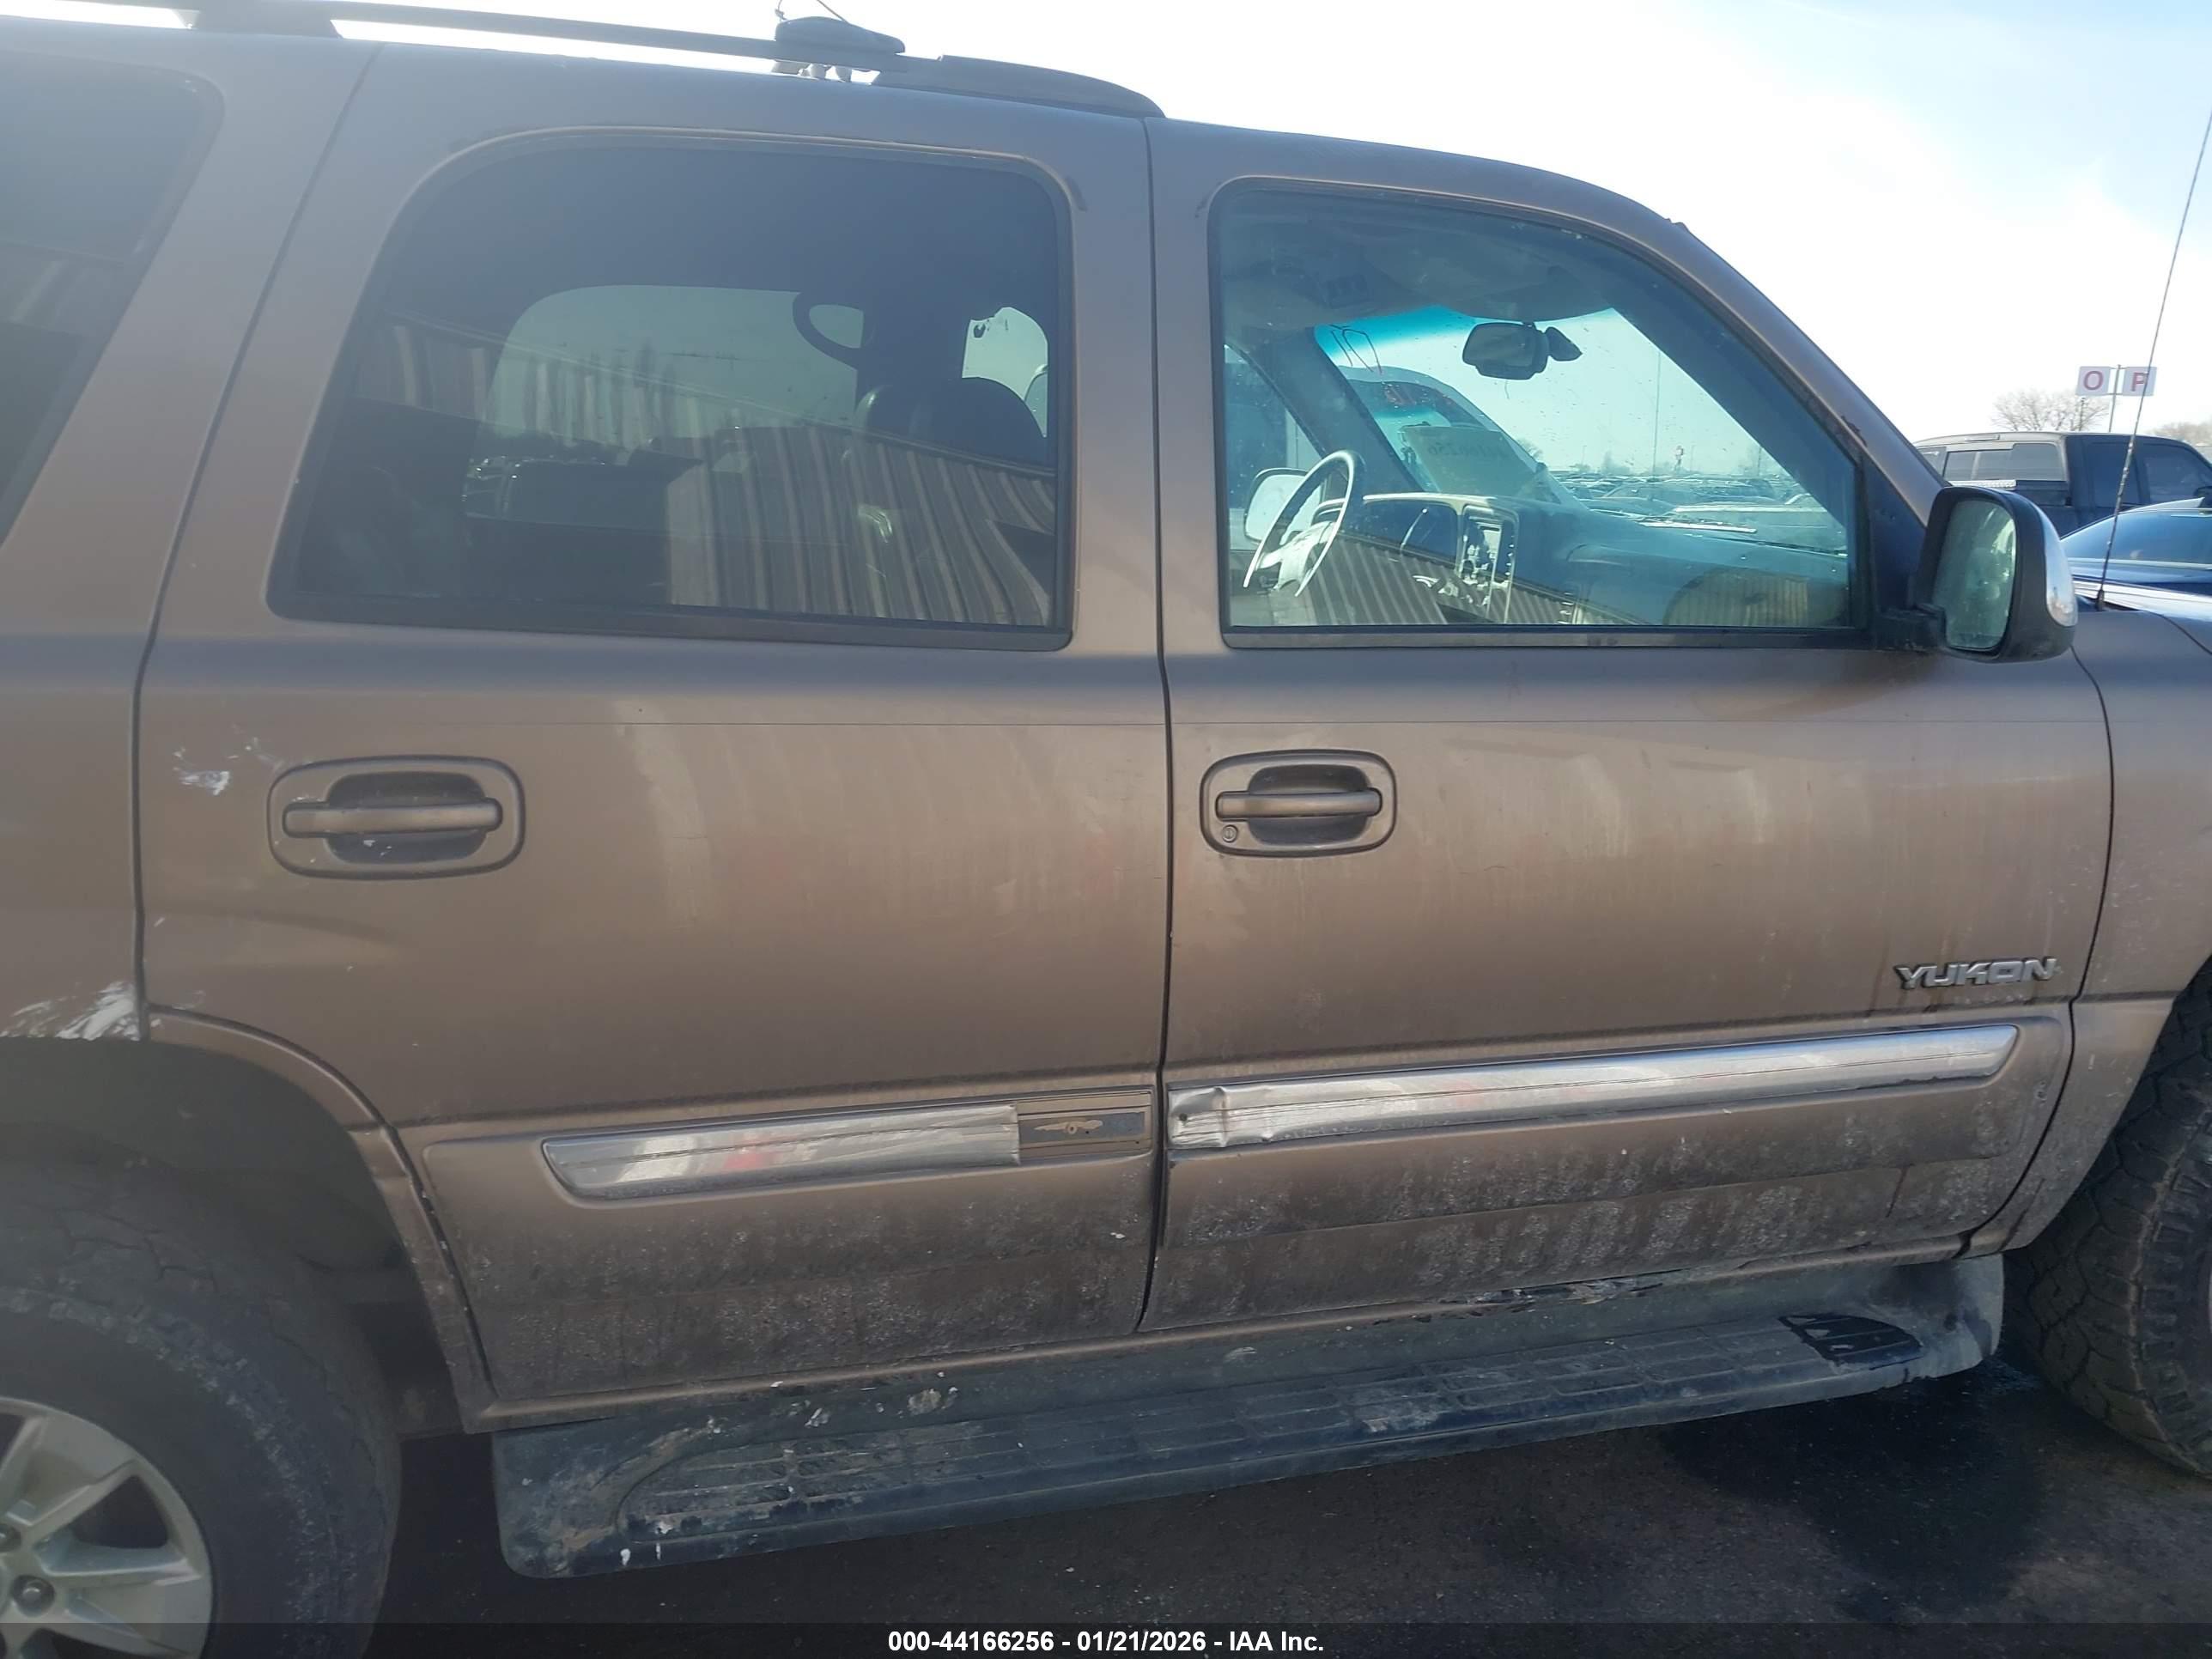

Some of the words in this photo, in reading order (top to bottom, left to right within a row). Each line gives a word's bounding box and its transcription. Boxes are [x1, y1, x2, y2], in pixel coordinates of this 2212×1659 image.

[2083, 370, 2104, 391] O
[2131, 372, 2149, 392] P
[1896, 957, 2057, 988] YUKON
